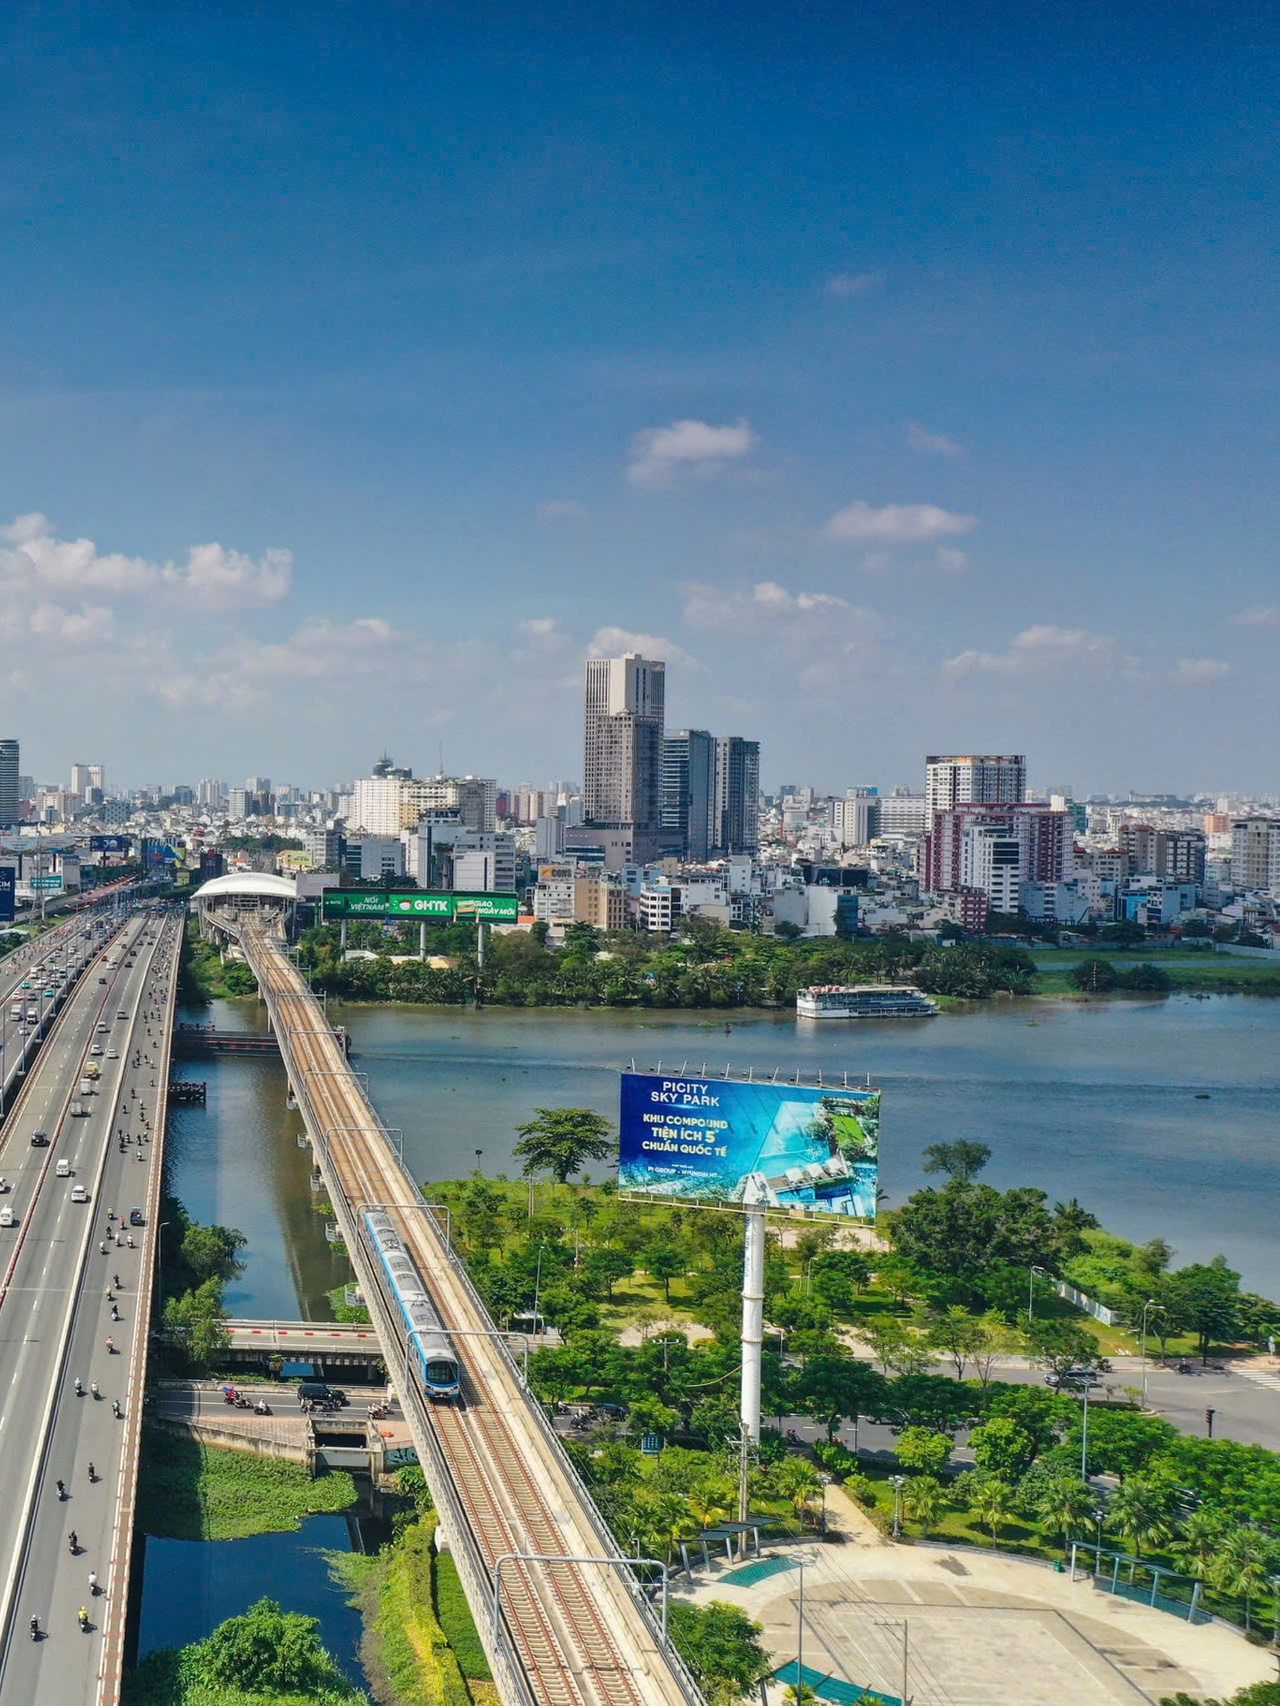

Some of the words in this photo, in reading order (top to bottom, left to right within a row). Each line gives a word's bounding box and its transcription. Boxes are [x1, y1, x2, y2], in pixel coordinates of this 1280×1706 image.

[413, 899, 448, 911] GHTK
[663, 1081, 709, 1095] PICITY
[650, 1091, 678, 1103] SKY
[683, 1094, 720, 1107] PARK
[643, 1113, 664, 1123] KHU
[666, 1116, 728, 1129] COMPOUND
[651, 1126, 678, 1141] TIỆN
[680, 1128, 703, 1141] ÍCH
[680, 1144, 713, 1156] QUỐC
[714, 1146, 728, 1157] TẾ
